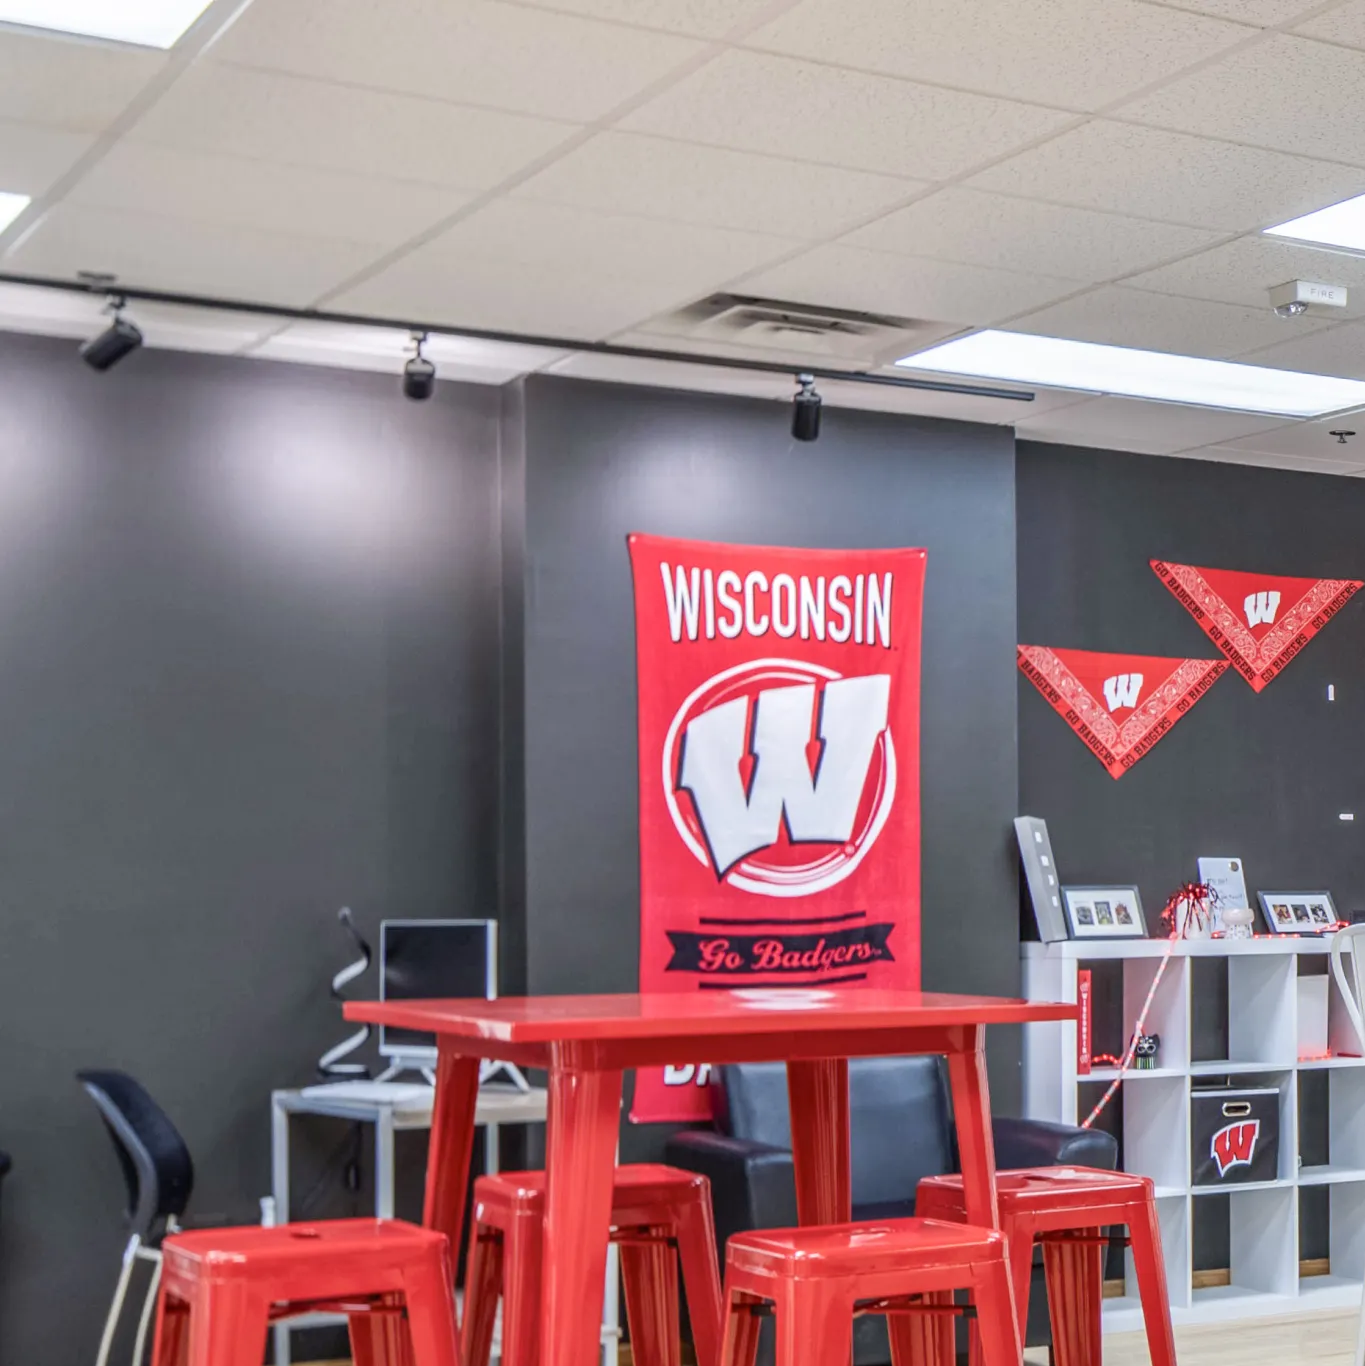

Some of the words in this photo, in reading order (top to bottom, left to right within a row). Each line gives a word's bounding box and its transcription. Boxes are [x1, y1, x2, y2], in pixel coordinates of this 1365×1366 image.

[1310, 288, 1334, 300] FIRE
[660, 562, 893, 649] WISCONSIN
[1154, 562, 1169, 578] GO
[1167, 576, 1205, 620] BADGERS
[1209, 626, 1223, 641] GO
[1221, 638, 1256, 682] BADGERS
[1243, 591, 1281, 629] W
[1260, 669, 1275, 684] GO
[1272, 633, 1308, 668] BADGERS
[1311, 614, 1326, 630] GO
[1323, 582, 1359, 617] BADGERS
[1021, 659, 1061, 705] BADGERS
[1065, 710, 1080, 725] GO
[1078, 722, 1116, 767] BADGERS
[1102, 673, 1144, 713] W
[1120, 754, 1136, 769] GO
[1133, 716, 1173, 757] BADGERS
[1176, 699, 1191, 713] GO
[1188, 661, 1227, 701] BADGERS
[673, 674, 892, 884] W
[698, 938, 744, 971] Go
[751, 937, 872, 974] Badgers
[1210, 1119, 1261, 1178] W
